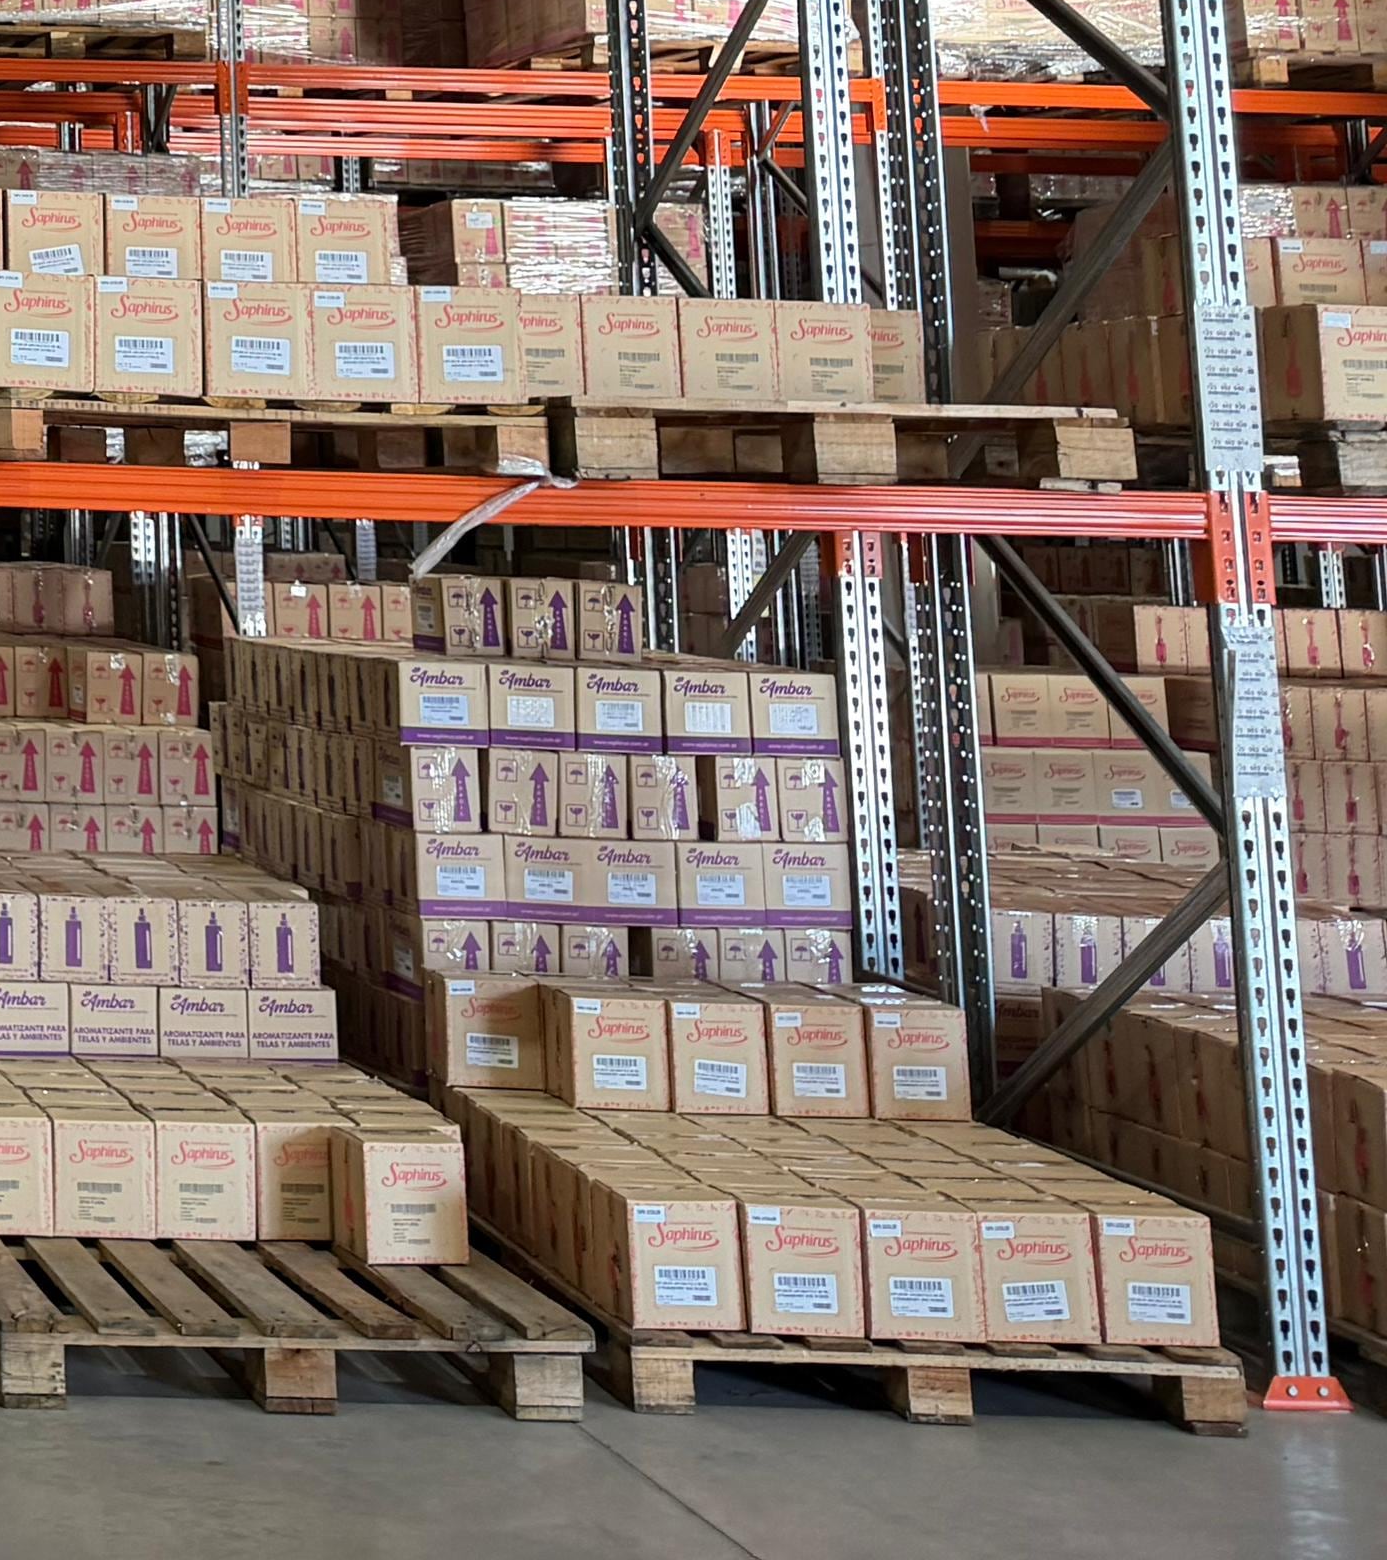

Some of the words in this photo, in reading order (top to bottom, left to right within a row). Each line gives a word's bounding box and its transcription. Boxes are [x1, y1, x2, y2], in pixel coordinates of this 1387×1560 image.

[22, 206, 82, 230] Saphirus
[123, 211, 183, 235] Saphirus
[217, 213, 277, 237] Saphirus
[310, 213, 371, 237] Saphirus
[4, 289, 72, 317] Saphirus
[111, 295, 179, 323] Saphirus
[224, 297, 293, 324] Saphirus
[327, 306, 396, 329] Saphirus
[435, 304, 505, 331] Saphirus
[519, 316, 563, 334] phirus
[599, 312, 660, 337] Saphirus
[697, 315, 758, 339] Saphirus
[791, 319, 854, 343] Saphirus
[412, 667, 466, 688] Ambar
[500, 671, 552, 690] Ambar
[588, 675, 640, 694] Ambar
[675, 677, 726, 696] Ambar
[761, 679, 813, 698] Ambar
[427, 839, 480, 858] Ambar
[515, 843, 571, 862] Ambar
[598, 846, 652, 865] Ambar
[686, 847, 740, 866] Ambar
[773, 848, 827, 867] Ambar
[81, 991, 136, 1011] Ambar
[171, 995, 225, 1014] Ambar
[259, 996, 314, 1016] Ambar
[461, 997, 521, 1020] Saphirus
[10, 1032, 16, 1040] Y
[18, 1032, 63, 1041] AMBIENTES
[48, 1024, 67, 1033] PARA
[74, 1027, 136, 1036] AROMATIZANTE
[137, 1028, 156, 1036] PARA
[77, 1035, 98, 1044] TELAS
[100, 1035, 106, 1044] Y
[107, 1035, 152, 1045] AMBIENTES
[163, 1030, 225, 1039] AROMATIZANTE
[226, 1031, 245, 1040] PARA
[252, 1032, 314, 1040] AROMATIZANTE
[315, 1032, 335, 1041] PARA
[588, 1017, 650, 1041] Saphirus
[687, 1020, 748, 1044] Saphirus
[788, 1023, 849, 1048] Saphirus
[888, 1025, 949, 1049] Saphirus
[167, 1038, 188, 1047] TELAS
[190, 1039, 196, 1047] Y
[197, 1039, 242, 1048] AMBIENTES
[256, 1040, 277, 1049] TELAS
[278, 1040, 284, 1048] Y
[286, 1040, 331, 1049] AMBIENTES
[69, 1139, 135, 1167] Saphirus
[171, 1141, 235, 1169] Saphirus
[382, 1161, 447, 1190] Saphirus
[648, 1223, 720, 1251] Saphirus
[766, 1226, 840, 1256] Saphirus
[885, 1237, 958, 1261] Saphirus
[998, 1238, 1072, 1264] Saphirus
[1120, 1236, 1193, 1266] Saphirus
